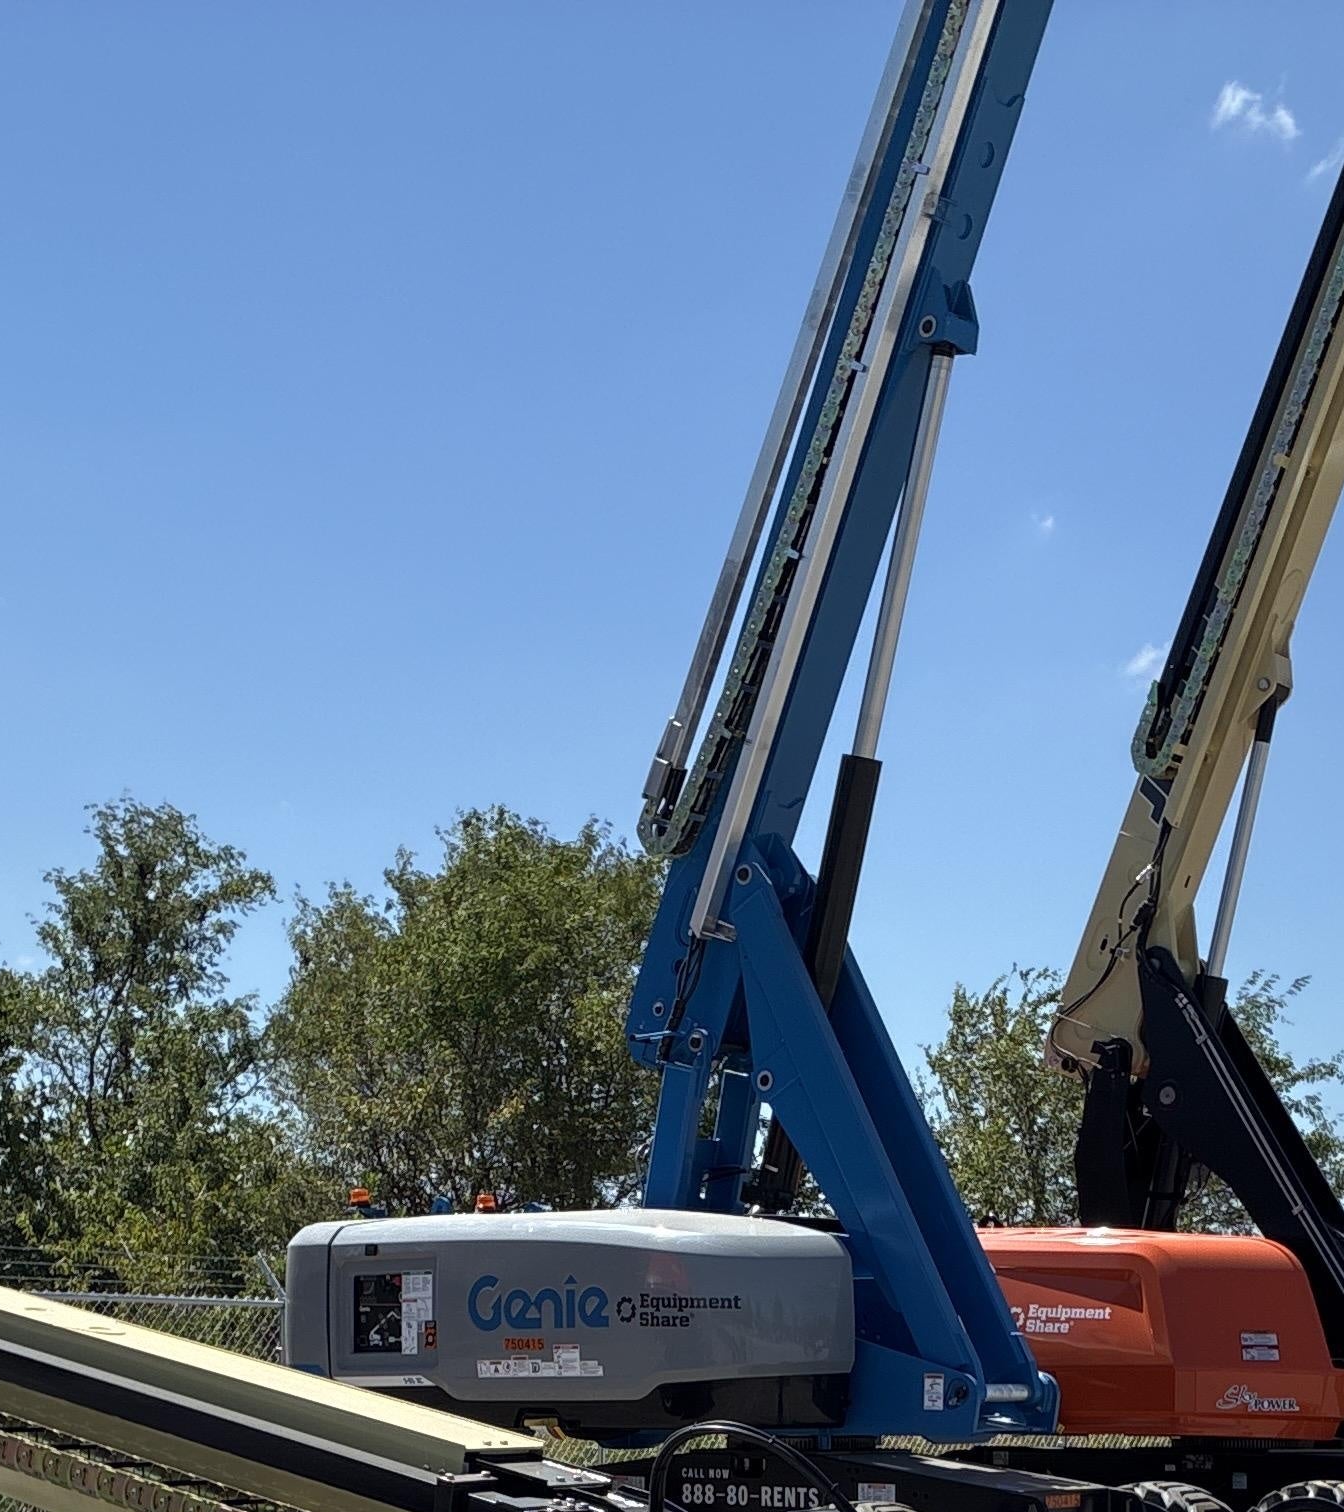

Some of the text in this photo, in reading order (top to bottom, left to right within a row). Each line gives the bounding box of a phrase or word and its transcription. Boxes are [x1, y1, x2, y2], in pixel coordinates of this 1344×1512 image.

[467, 1273, 610, 1332] Genie
[639, 1293, 742, 1311] Equipment
[639, 1311, 691, 1328] Share
[1028, 1303, 1112, 1321] Equipment
[1026, 1319, 1070, 1334] Share
[505, 1338, 544, 1351] 750415
[681, 1467, 730, 1480] CALL NOW
[681, 1482, 820, 1509] 888-80-RENTS
